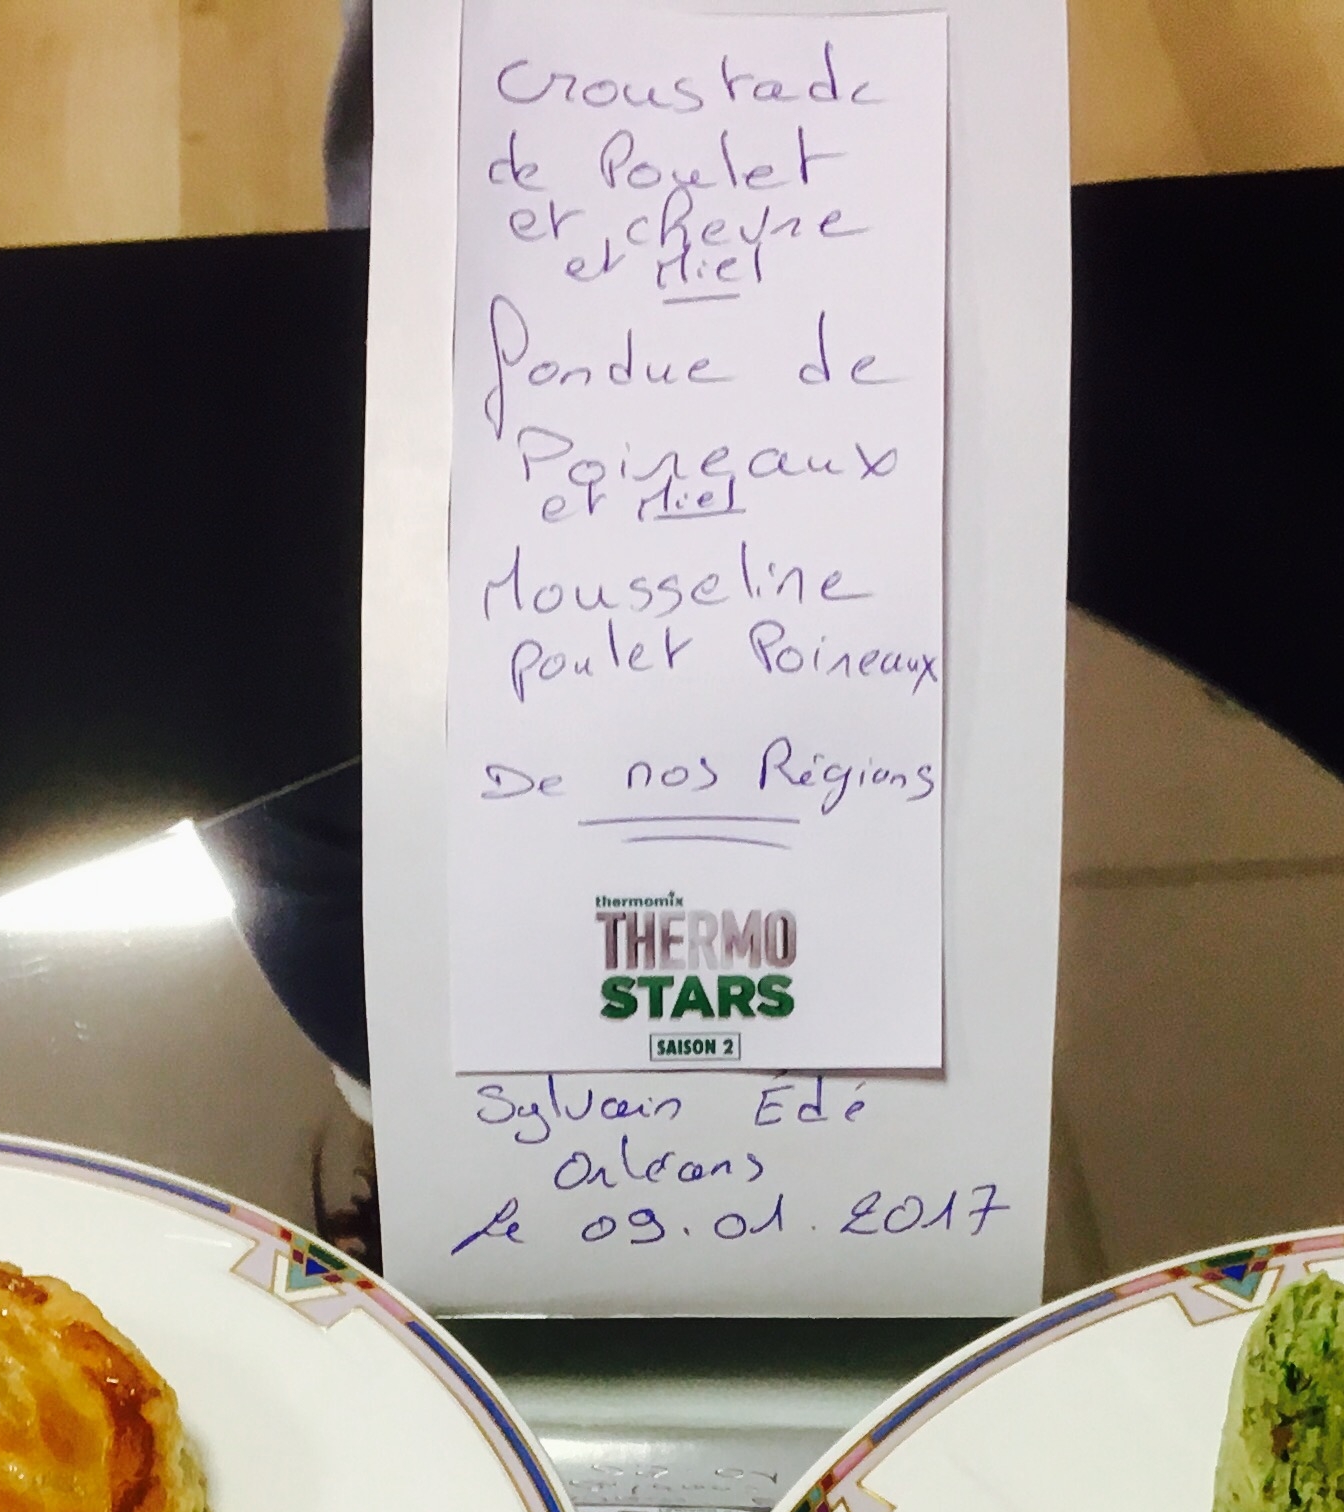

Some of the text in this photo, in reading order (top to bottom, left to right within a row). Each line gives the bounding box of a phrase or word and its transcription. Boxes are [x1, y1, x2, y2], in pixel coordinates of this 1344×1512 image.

[497, 40, 887, 114] Croustade
[488, 126, 848, 191] de Poulet
[509, 200, 584, 242] et
[565, 239, 626, 281] et
[797, 310, 918, 387] de
[516, 426, 899, 486] Poireaux
[541, 485, 606, 523] et
[482, 540, 874, 620] Mousseline
[748, 619, 938, 696] Poireaux
[481, 736, 936, 815] De nos Régions
[595, 890, 684, 908] thermomix
[596, 908, 798, 971] THERMO
[599, 974, 795, 1021] STARS
[656, 1038, 734, 1055] SAISON 2
[476, 1074, 683, 1143] Sylvain
[554, 1134, 766, 1190] Orléans
